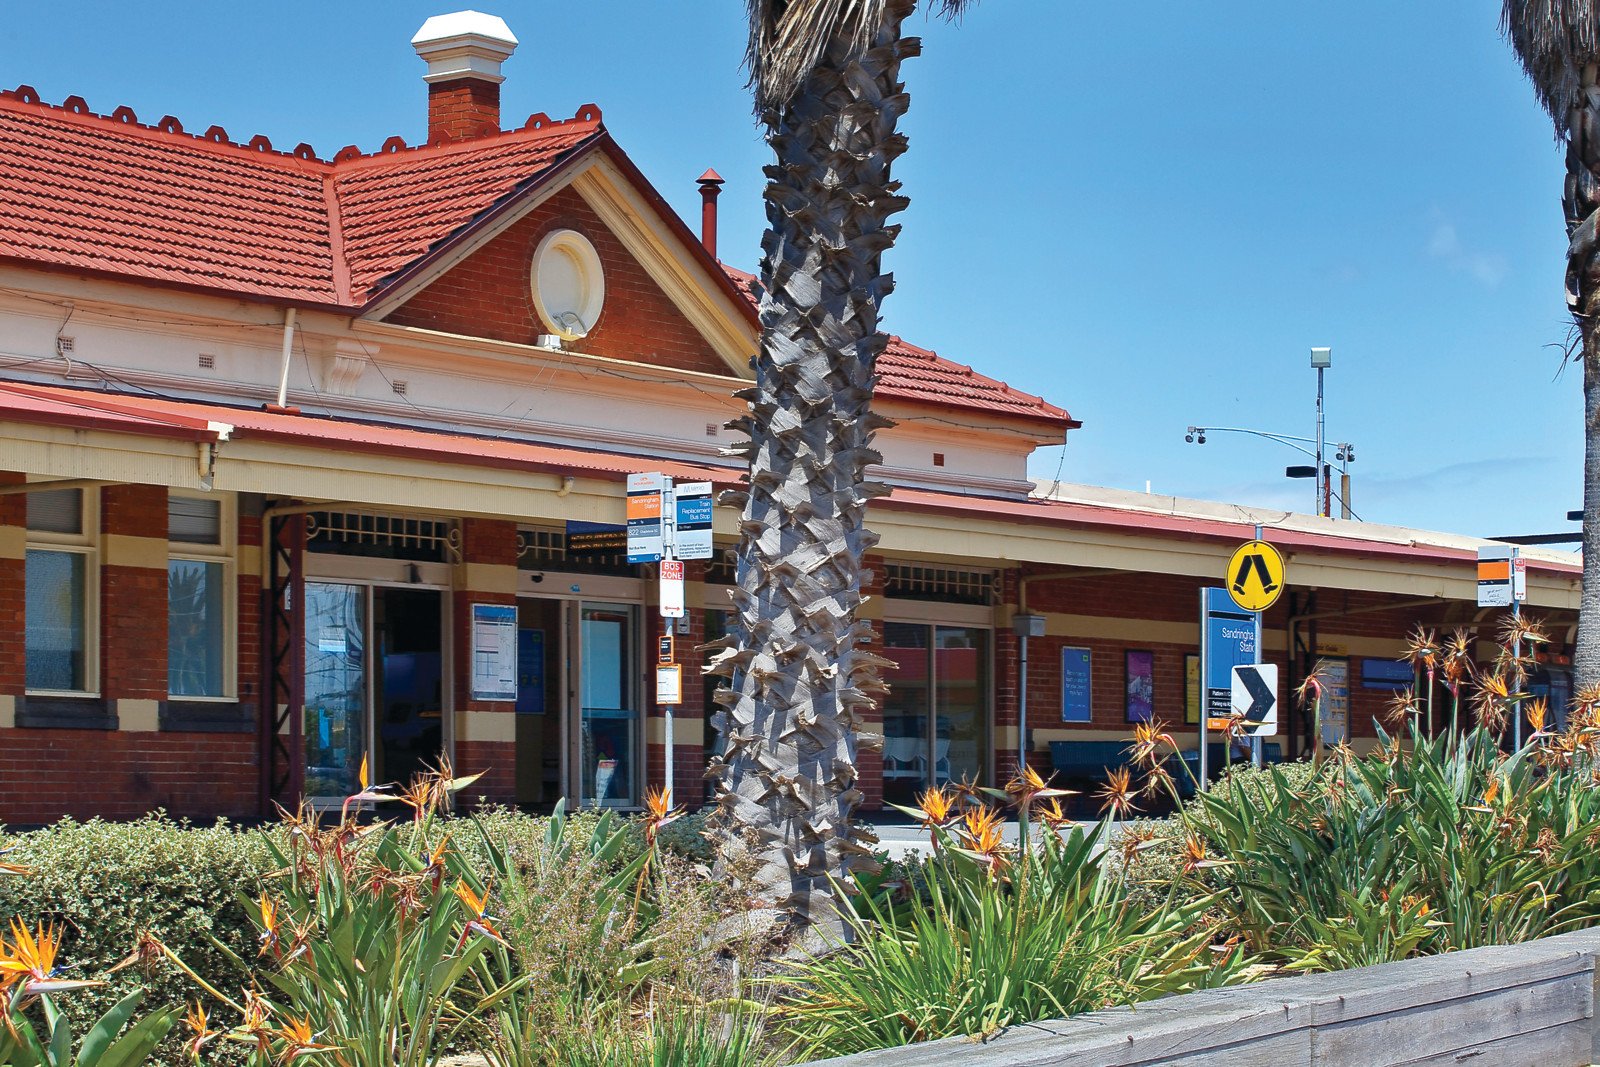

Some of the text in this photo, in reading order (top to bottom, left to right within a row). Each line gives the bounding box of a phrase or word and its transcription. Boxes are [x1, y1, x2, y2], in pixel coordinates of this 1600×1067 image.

[664, 562, 680, 570] BUS
[662, 571, 682, 579] ZONE
[1222, 627, 1254, 642] Sandringha
